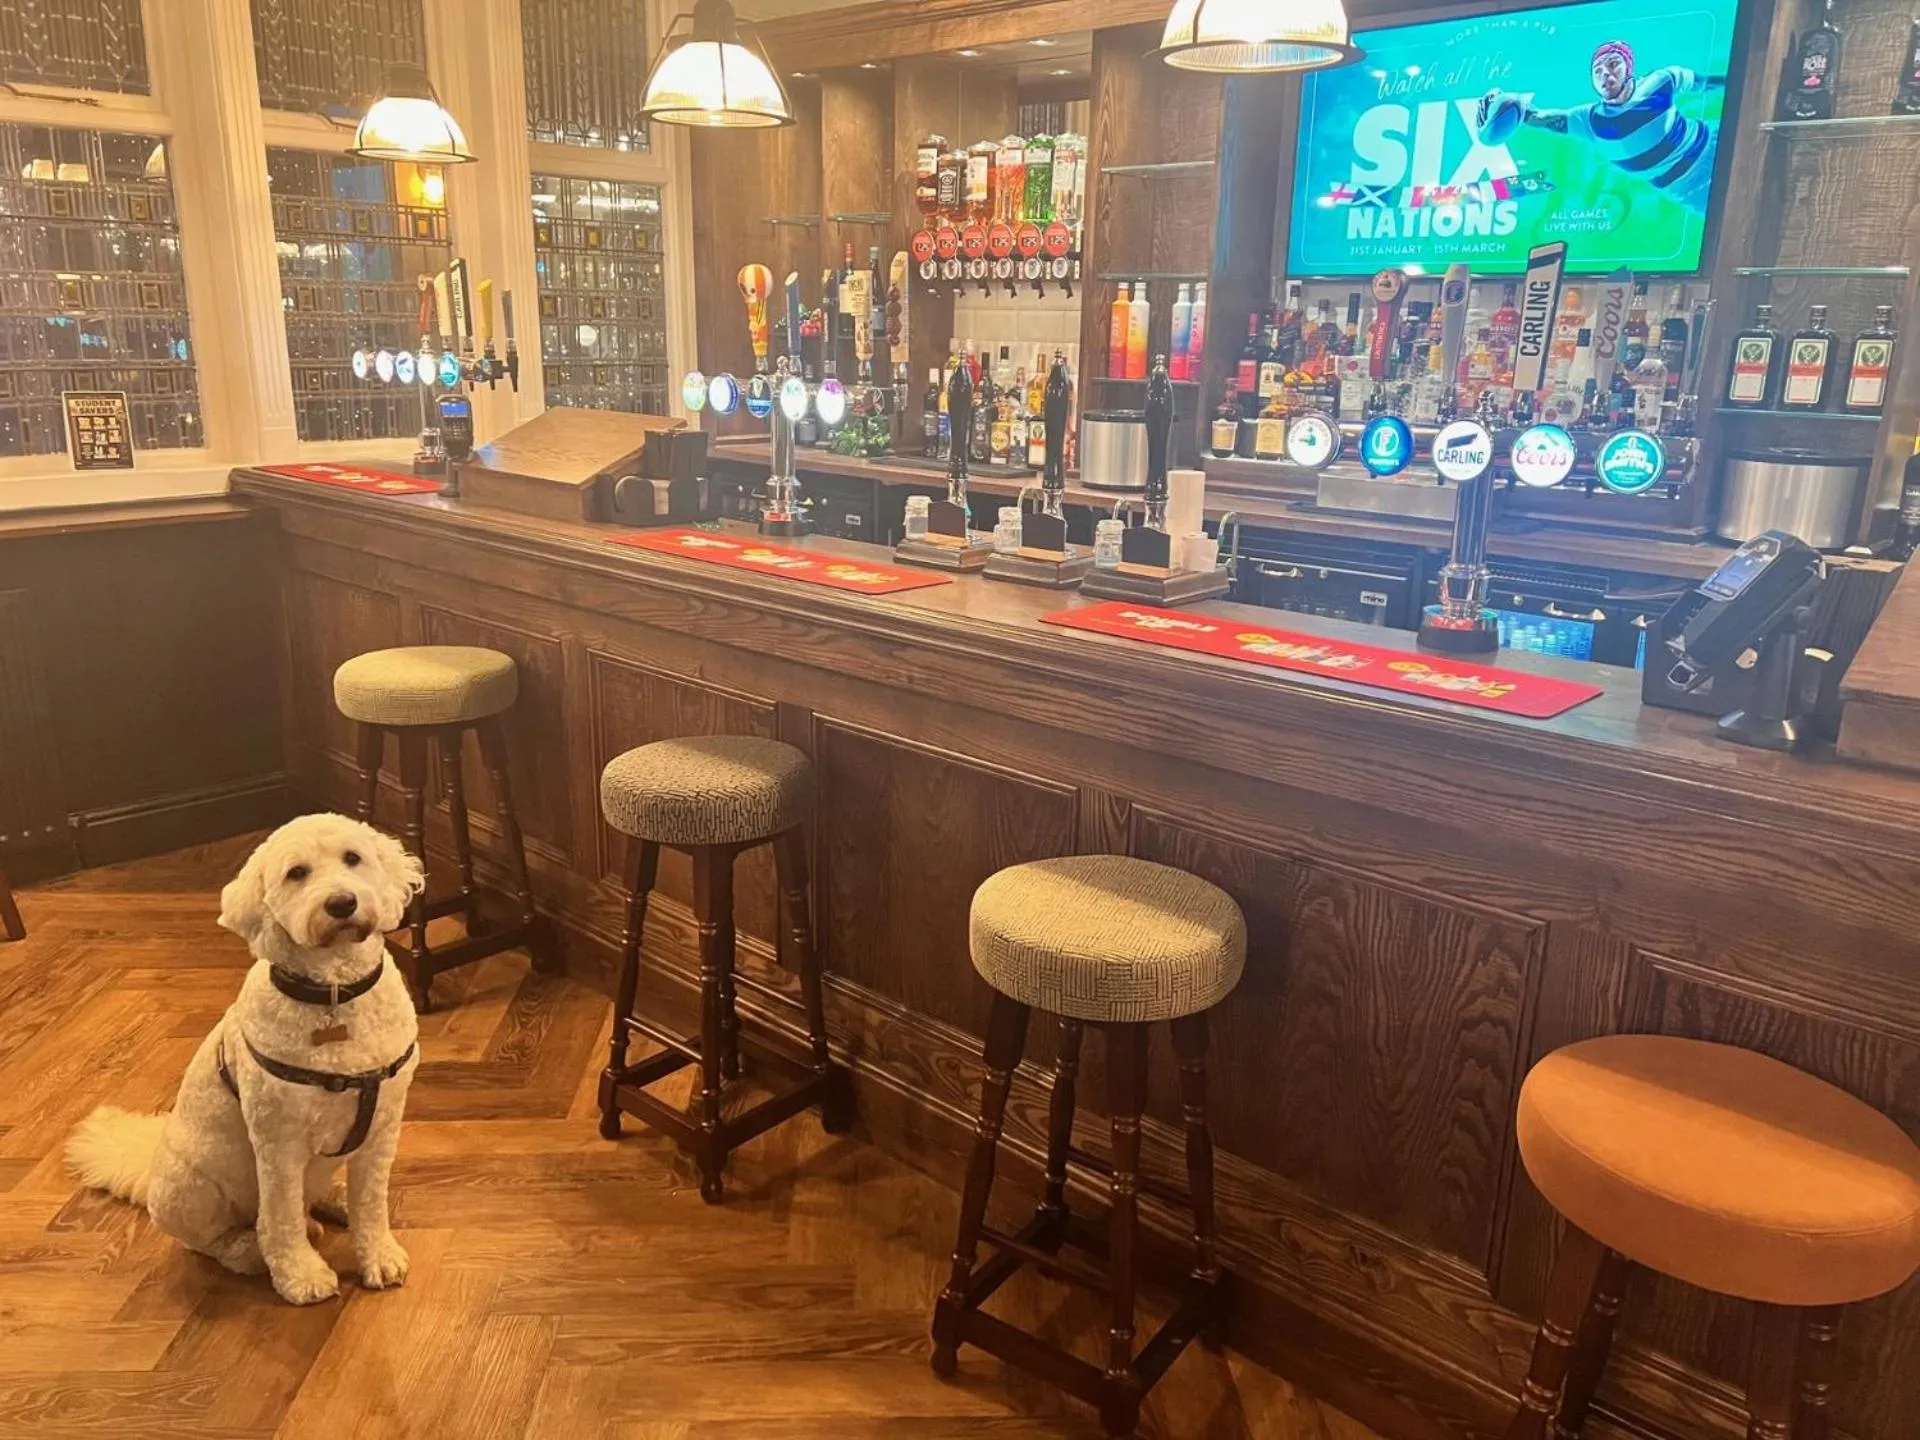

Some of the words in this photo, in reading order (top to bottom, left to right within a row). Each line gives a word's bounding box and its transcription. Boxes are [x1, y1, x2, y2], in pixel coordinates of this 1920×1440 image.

[1377, 62, 1439, 101] Watch
[1443, 57, 1478, 88] all
[1482, 51, 1513, 81] the
[1350, 92, 1536, 194] SIX
[1347, 203, 1519, 239] NATIONS
[1551, 211, 1569, 220] ALL
[1571, 208, 1608, 219] GAMES
[1371, 244, 1422, 255] JANUARY
[1461, 242, 1506, 253] MARCH
[1519, 279, 1551, 358] CARLING
[1595, 286, 1625, 360] Coors
[1437, 448, 1485, 465] CARLING
[1515, 446, 1567, 467] Coors
